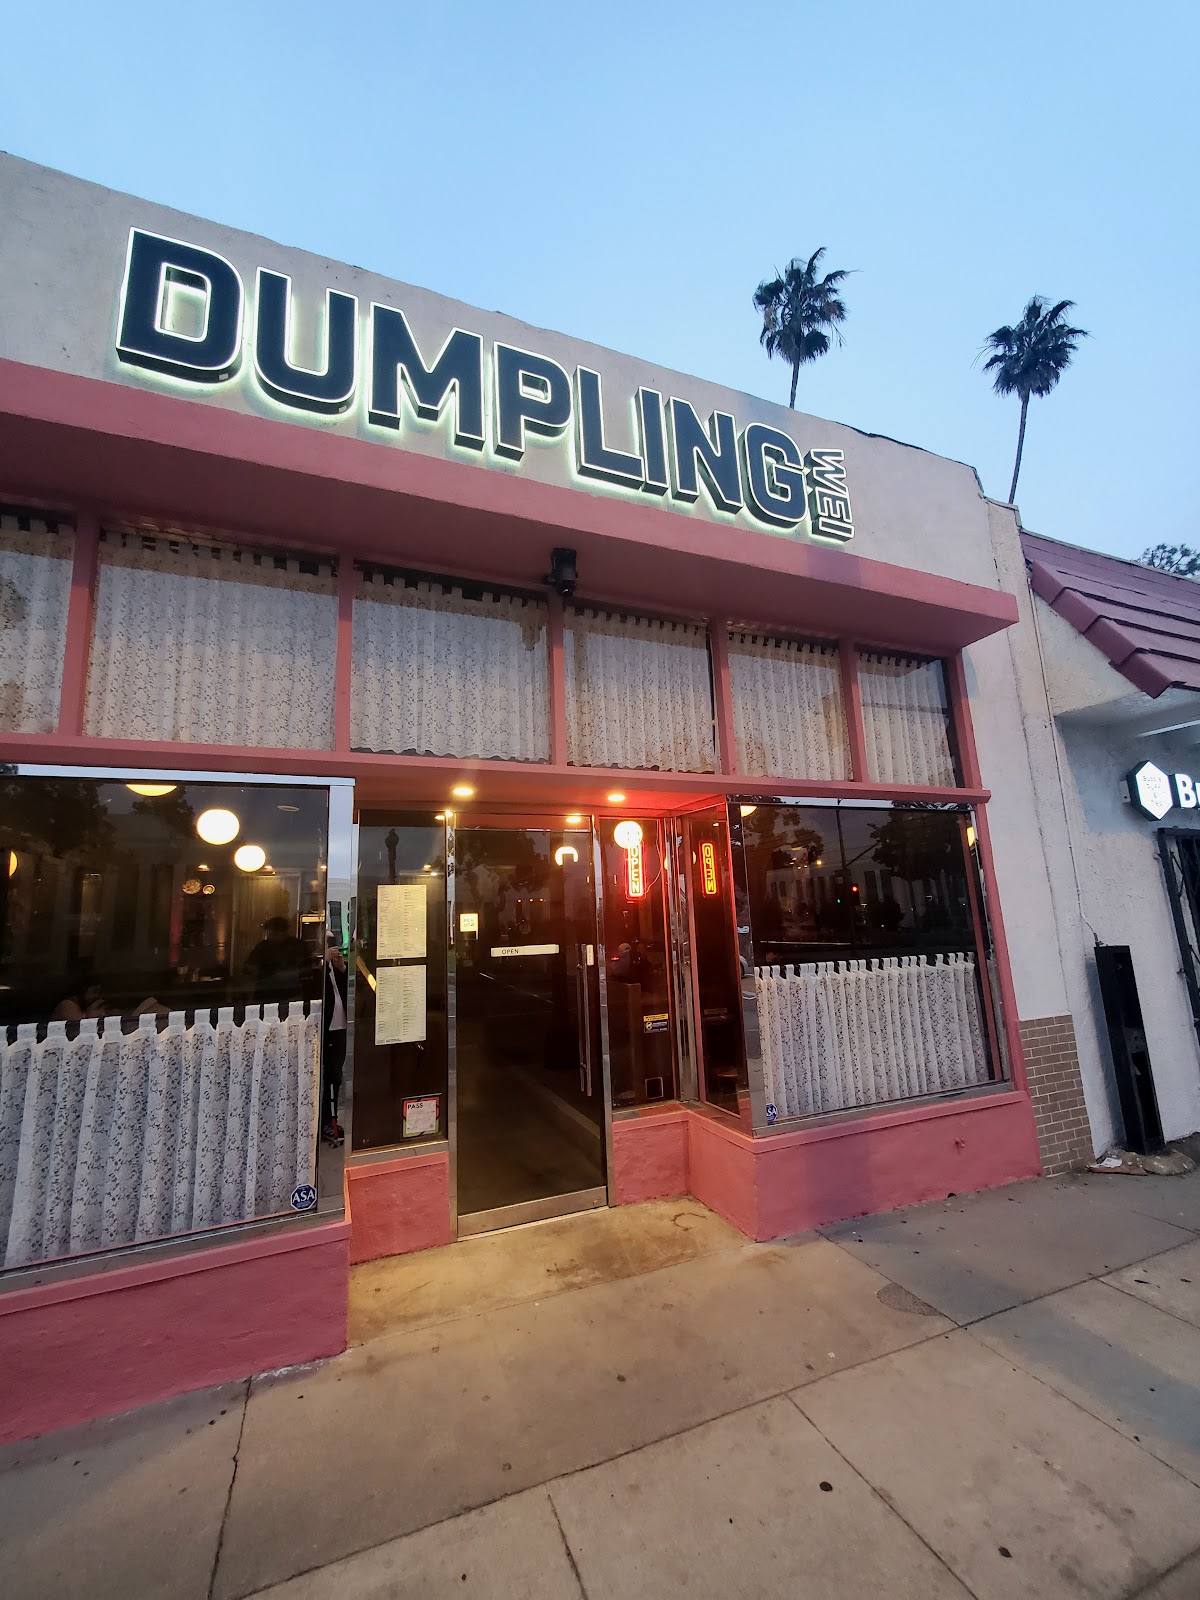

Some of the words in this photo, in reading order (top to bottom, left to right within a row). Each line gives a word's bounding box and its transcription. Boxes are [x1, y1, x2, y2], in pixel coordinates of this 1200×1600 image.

[115, 226, 807, 527] DUMPLING
[809, 448, 855, 540] WEI
[1174, 773, 1200, 808] B
[407, 1102, 424, 1110] PASS
[292, 1189, 315, 1204] ASA
